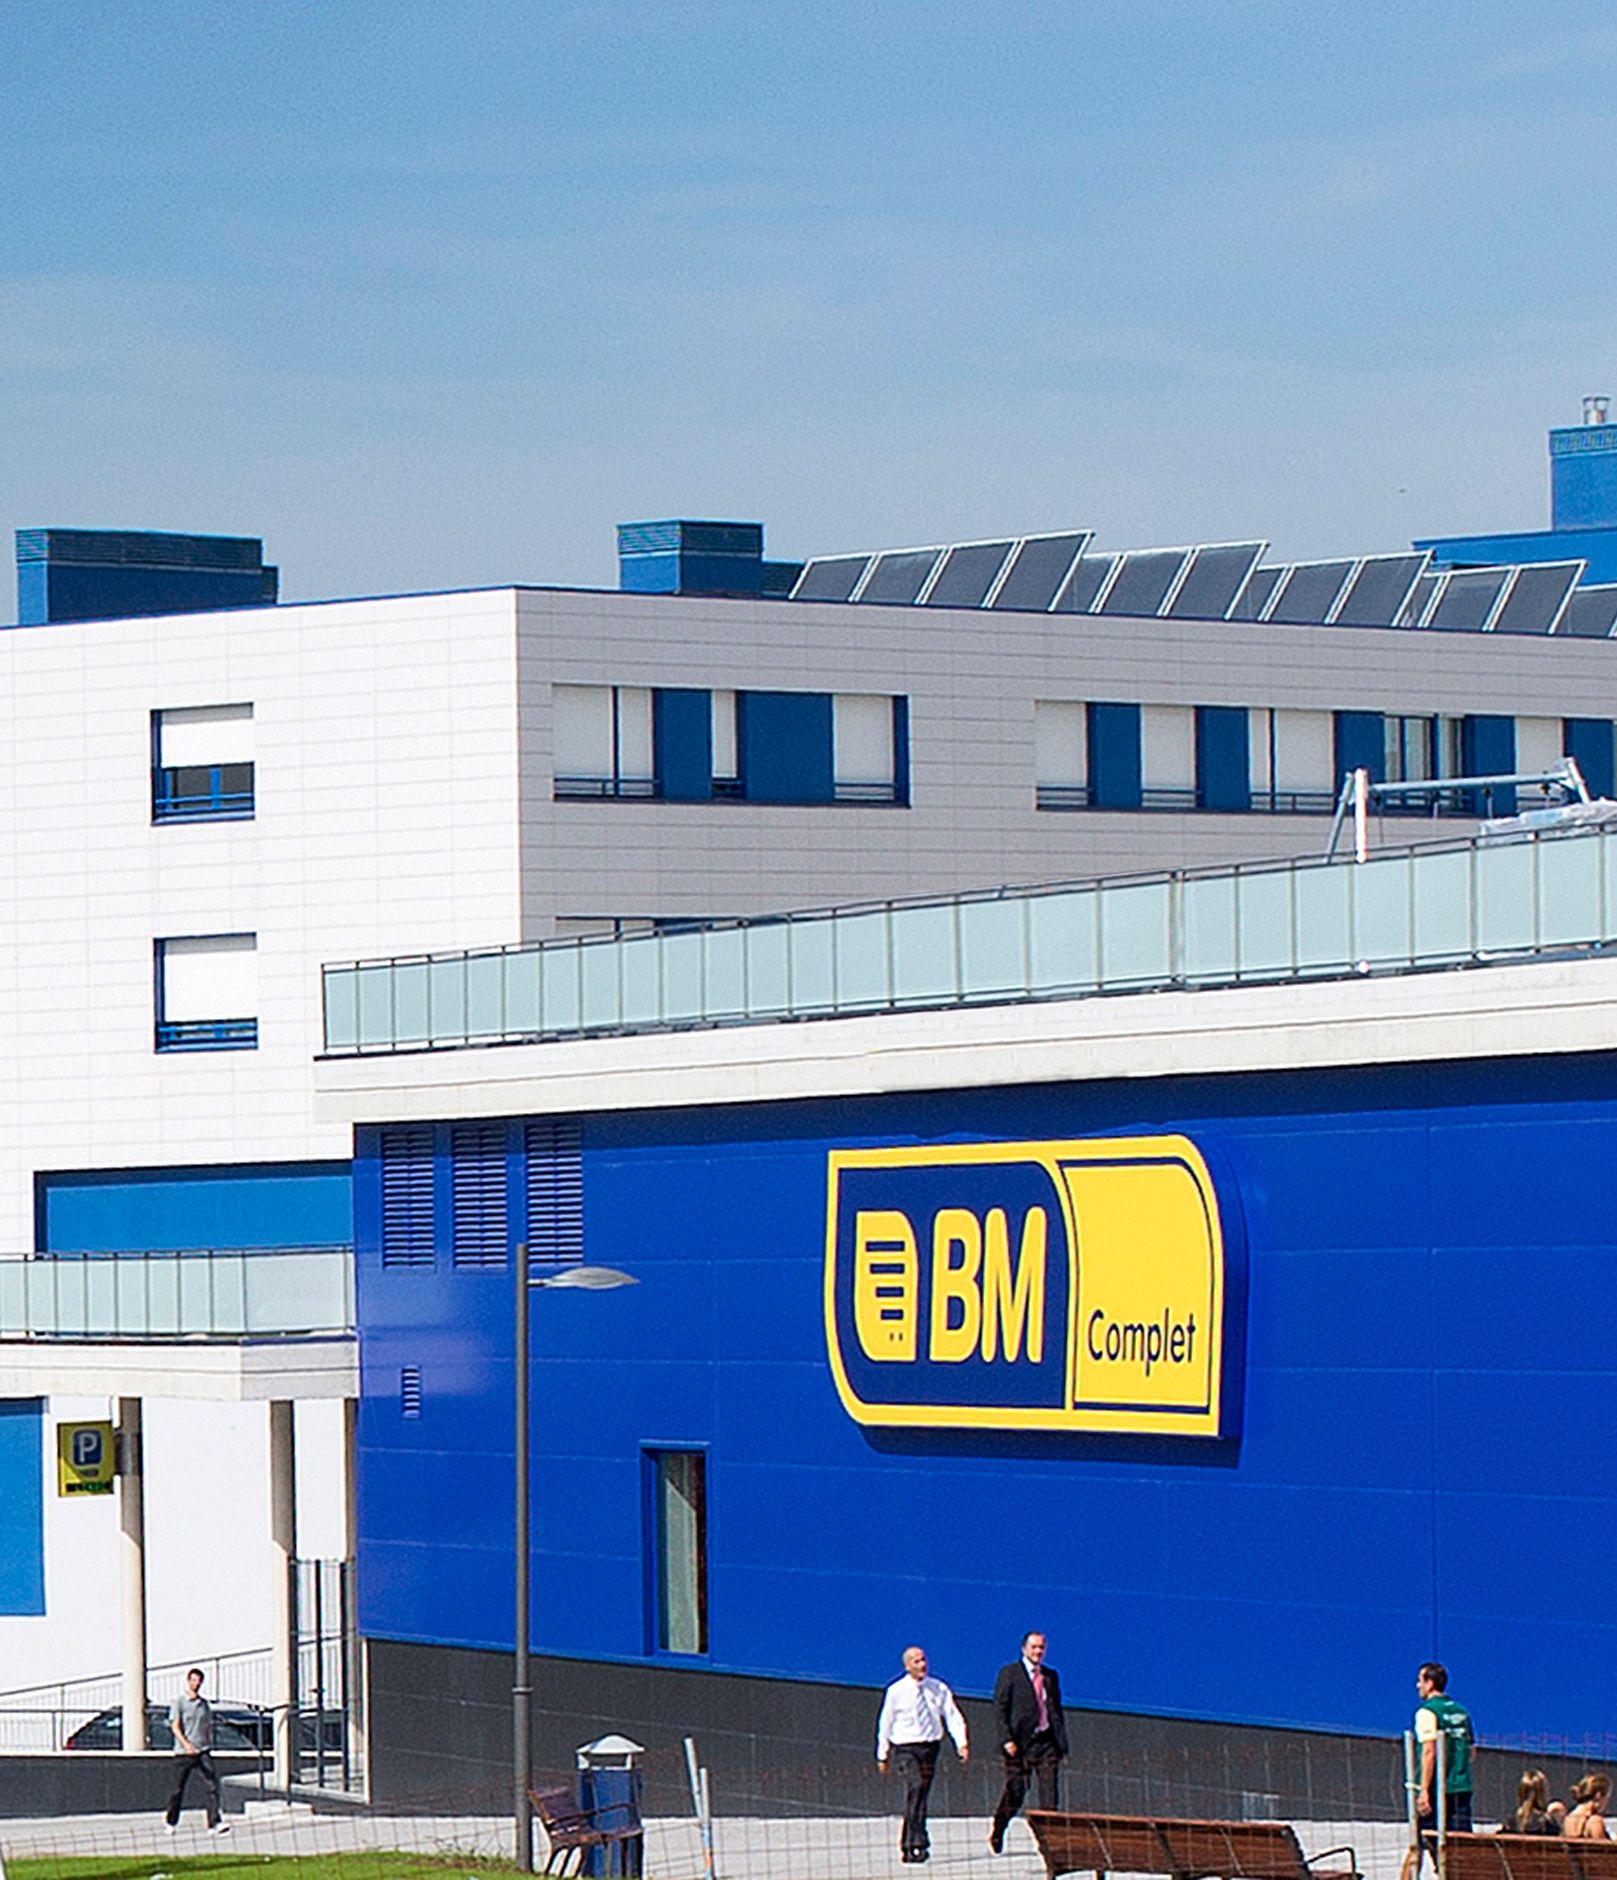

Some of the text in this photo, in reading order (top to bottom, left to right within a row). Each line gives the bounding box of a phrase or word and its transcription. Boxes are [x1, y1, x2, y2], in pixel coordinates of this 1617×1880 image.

[929, 1206, 1047, 1362] BM
[1087, 1307, 1196, 1377] Complet
[78, 1431, 98, 1463] P
